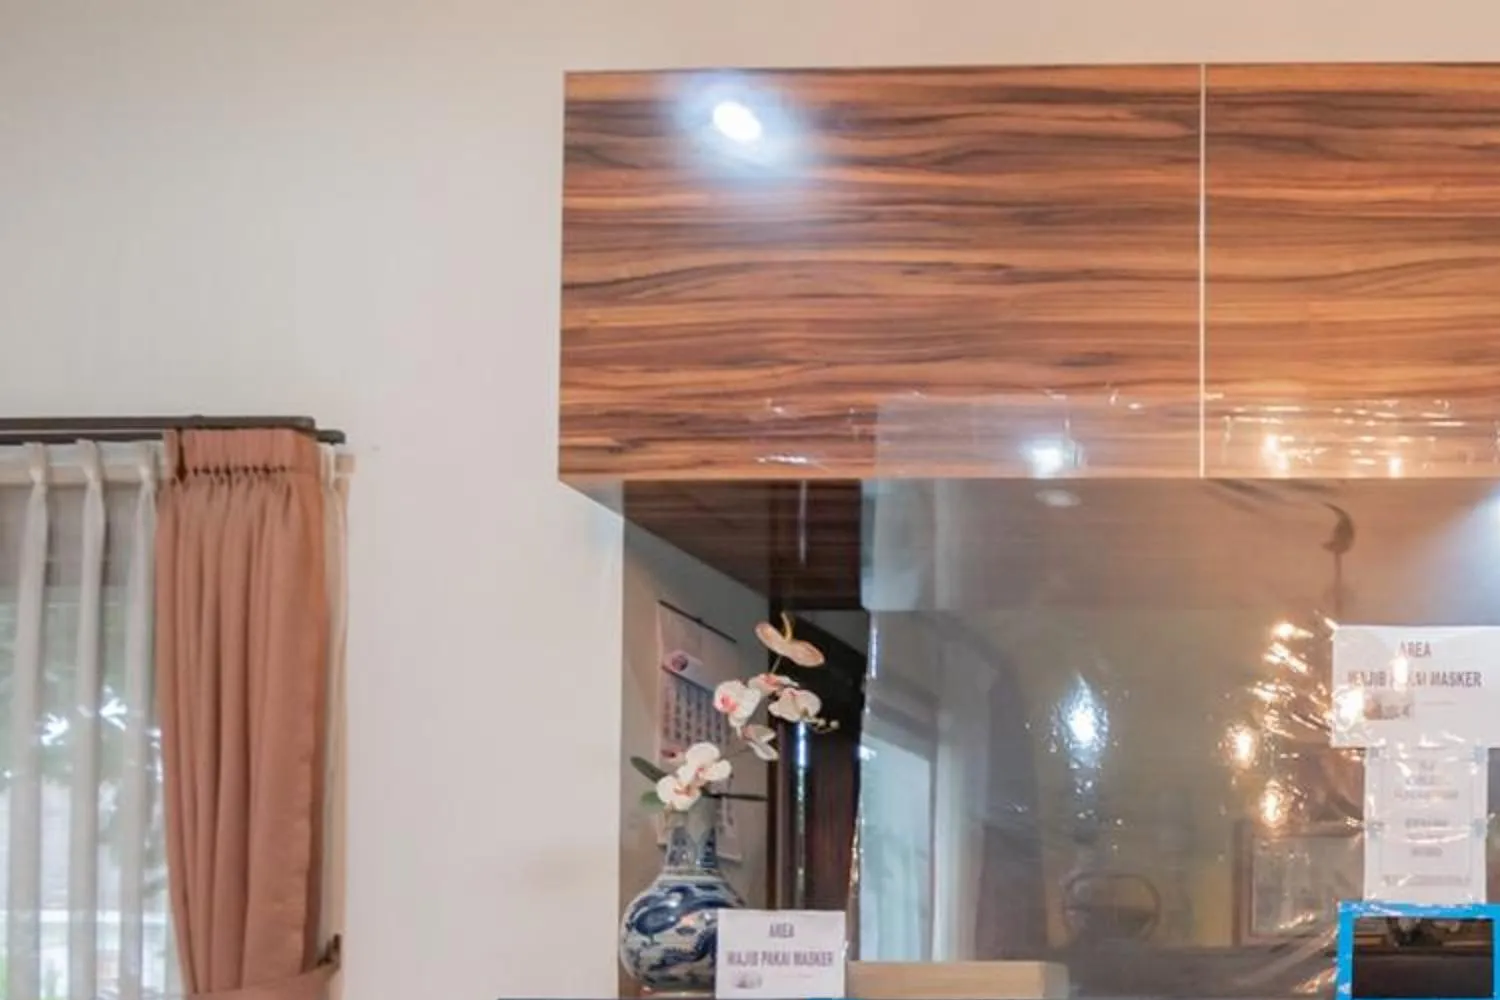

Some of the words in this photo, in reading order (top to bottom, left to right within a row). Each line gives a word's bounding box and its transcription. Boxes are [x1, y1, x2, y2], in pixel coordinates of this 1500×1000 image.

[1399, 640, 1432, 657] AREA
[1429, 670, 1482, 688] MASKER
[768, 922, 795, 938] AREA
[727, 950, 759, 967] WAJIB
[761, 950, 791, 967] PAKAI
[793, 950, 834, 967] MASKER
